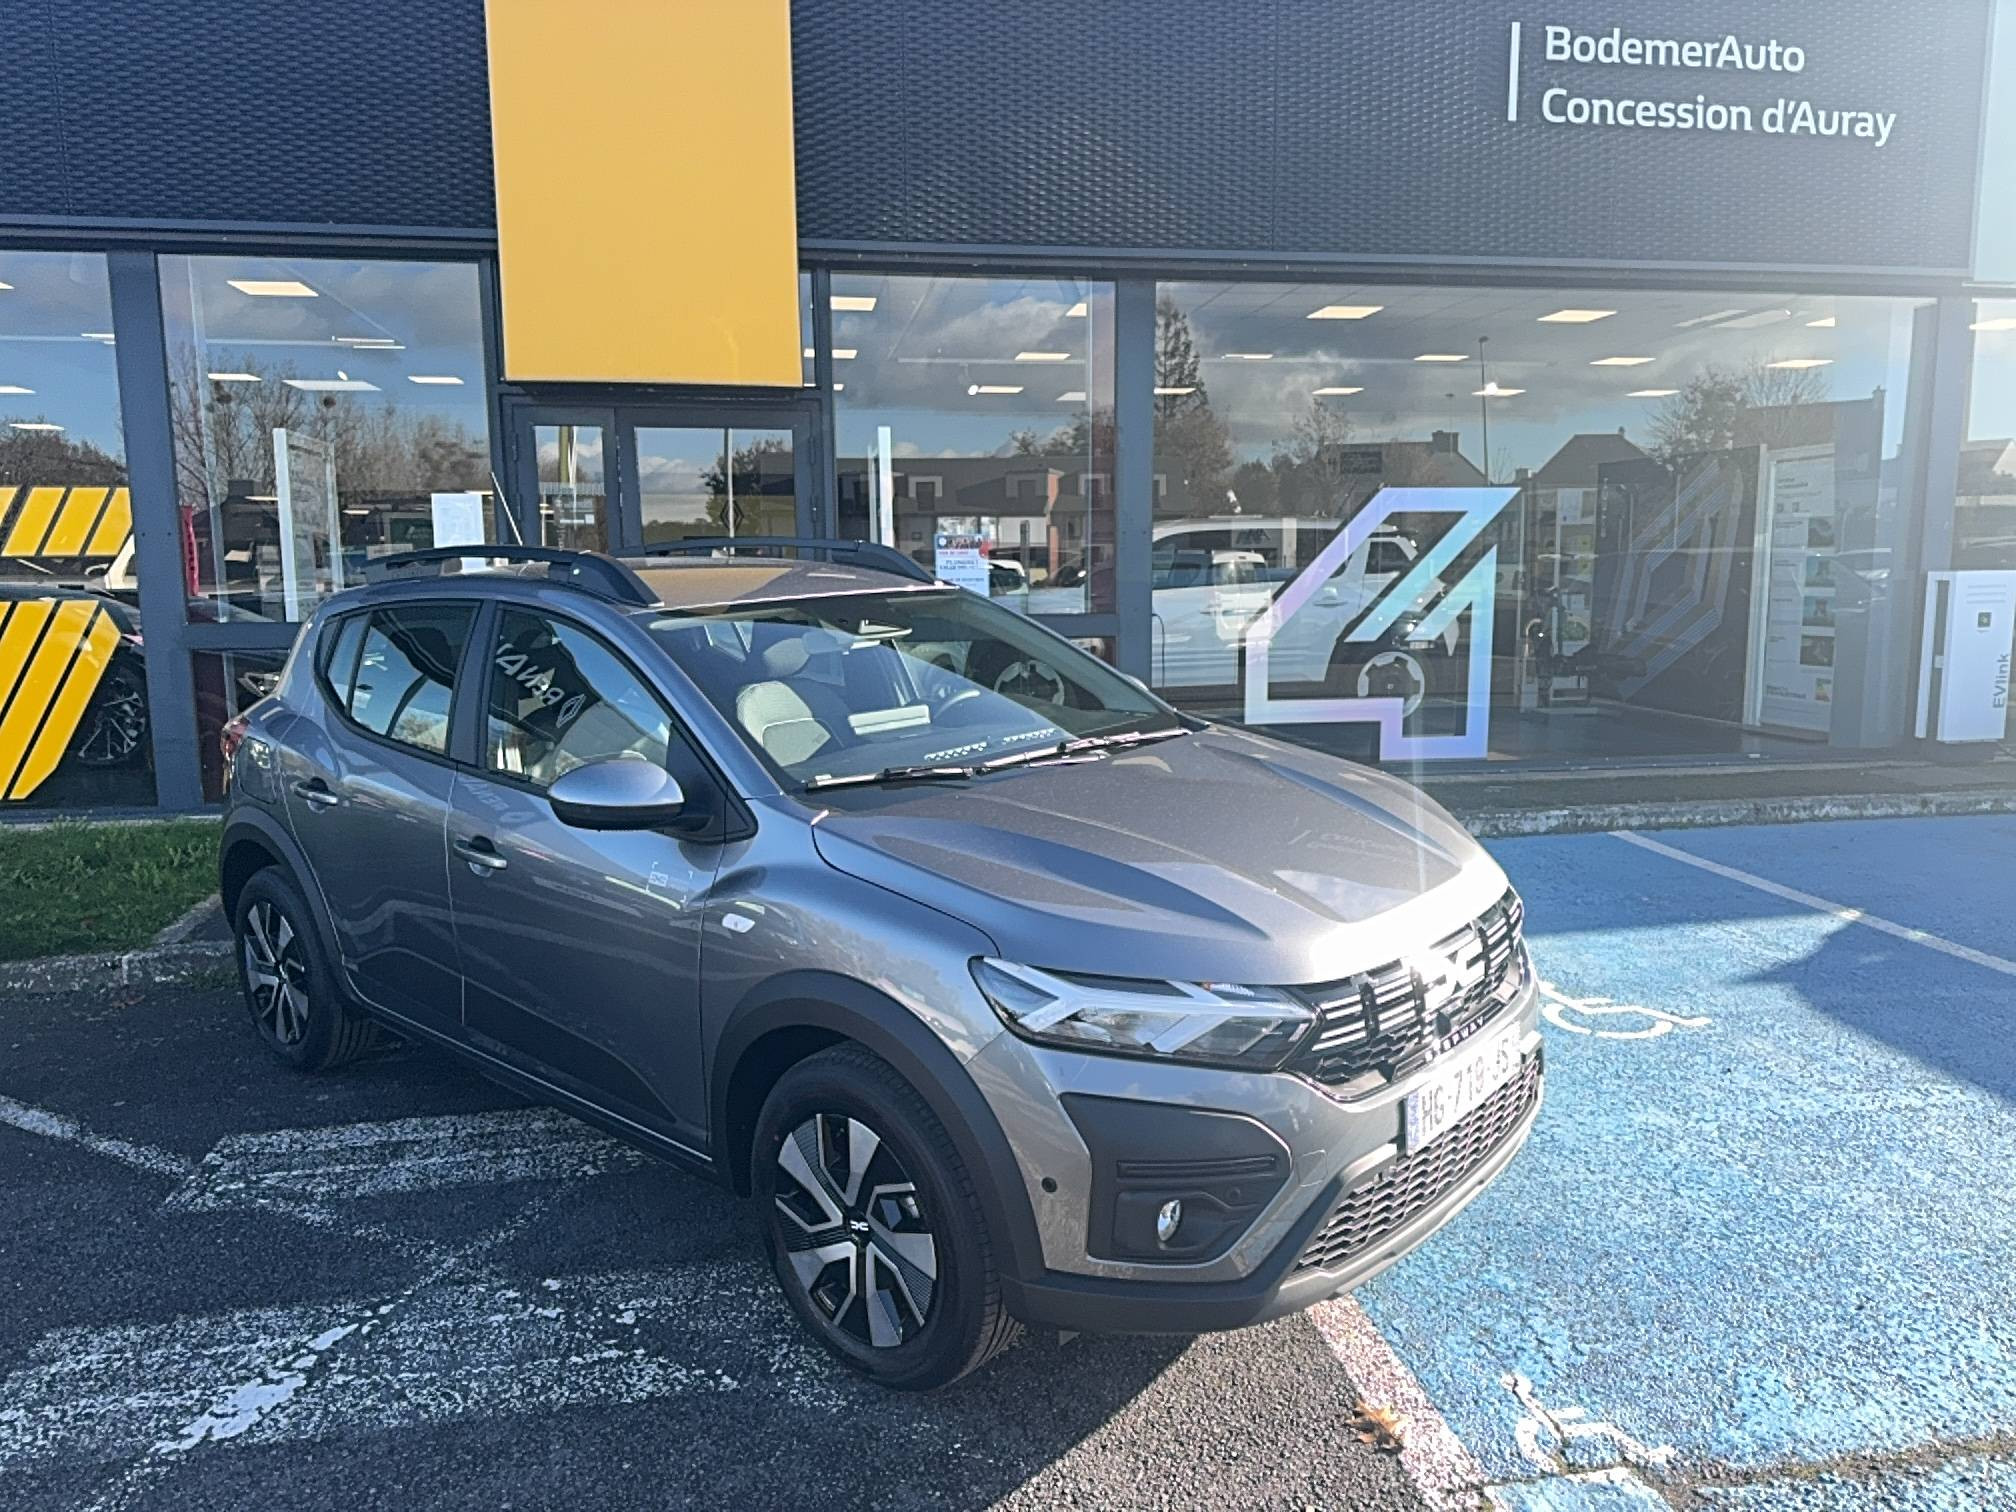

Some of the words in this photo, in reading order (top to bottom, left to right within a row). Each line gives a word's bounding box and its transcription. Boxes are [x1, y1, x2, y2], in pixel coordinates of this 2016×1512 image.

[1545, 25, 1805, 72] BodemerAuto
[1541, 87, 1752, 131] Concession
[1761, 98, 1897, 147] d'Auray
[1992, 653, 2009, 709] EVlink
